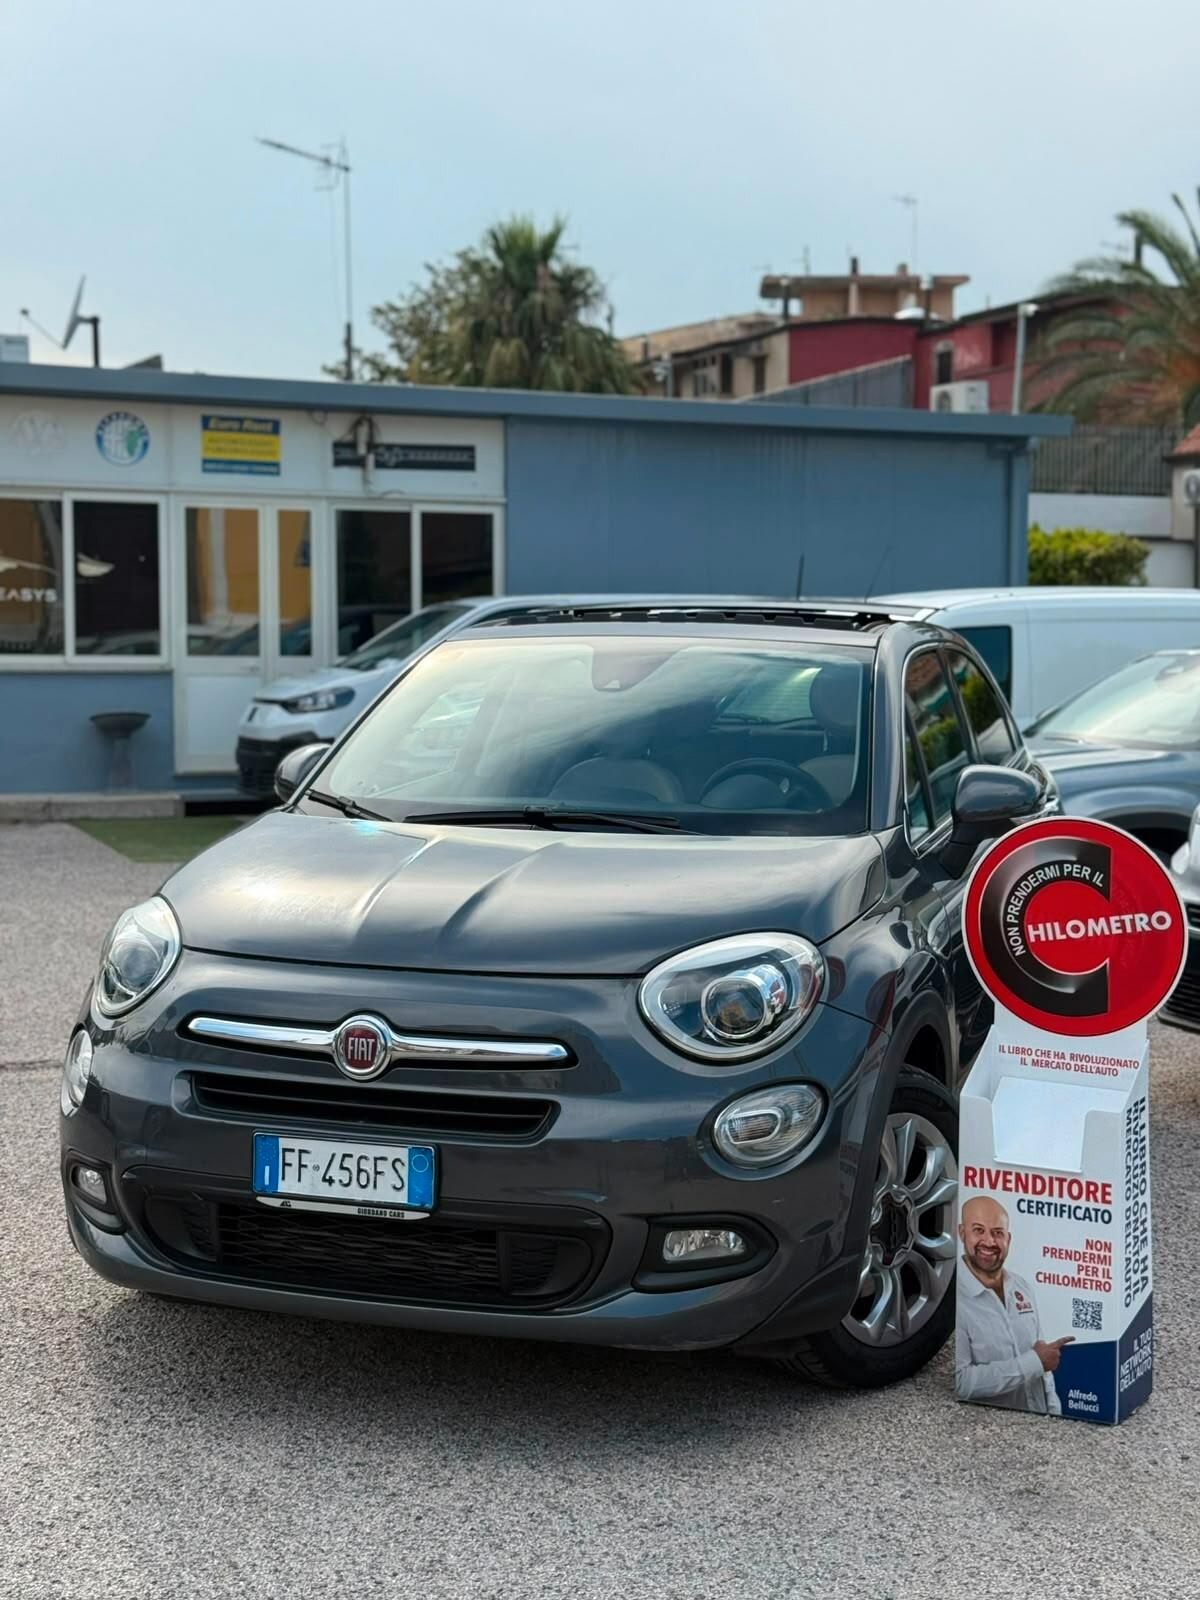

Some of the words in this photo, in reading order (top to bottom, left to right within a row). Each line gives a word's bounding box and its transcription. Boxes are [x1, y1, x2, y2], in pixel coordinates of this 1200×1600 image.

[1063, 863, 1091, 880] PER
[1092, 871, 1104, 888] IL
[1006, 863, 1060, 924] PRENDERMI
[1007, 926, 1026, 957] NON
[348, 1037, 376, 1061] FIAT
[999, 1044, 1006, 1054] IL
[1008, 1046, 1032, 1057] LIBRO
[1035, 1048, 1051, 1060] CHE
[1053, 1050, 1066, 1061] HA
[1069, 1052, 1140, 1070] RIVOLUZIONATO
[1020, 1057, 1028, 1066] IL
[1031, 1058, 1072, 1071] MERCATO
[1073, 1063, 1119, 1077] DELL'AUTO
[1139, 1096, 1146, 1115] IL
[1139, 1123, 1147, 1196] LIBRO
[964, 1166, 1113, 1205] RIVENDITORE
[1132, 1100, 1140, 1274] RIVOLUZIONATO
[389, 1210, 405, 1219] CARS
[1016, 1198, 1112, 1225] CERTIFICATO
[1140, 1202, 1148, 1244] CHE
[1042, 1246, 1112, 1267] PRENDERMI
[1085, 1238, 1112, 1253] NON
[1124, 1205, 1132, 1308] DELL'AUTO
[1035, 1271, 1112, 1293] CHILOMETRO
[1077, 1264, 1099, 1278] PER
[1102, 1266, 1113, 1280] IL
[1140, 1255, 1149, 1294] HA
[1133, 1279, 1140, 1301] IL
[1120, 1341, 1153, 1378] NETWORK
[1068, 1389, 1098, 1402] Alfredo
[1068, 1400, 1100, 1413] Bellucci
